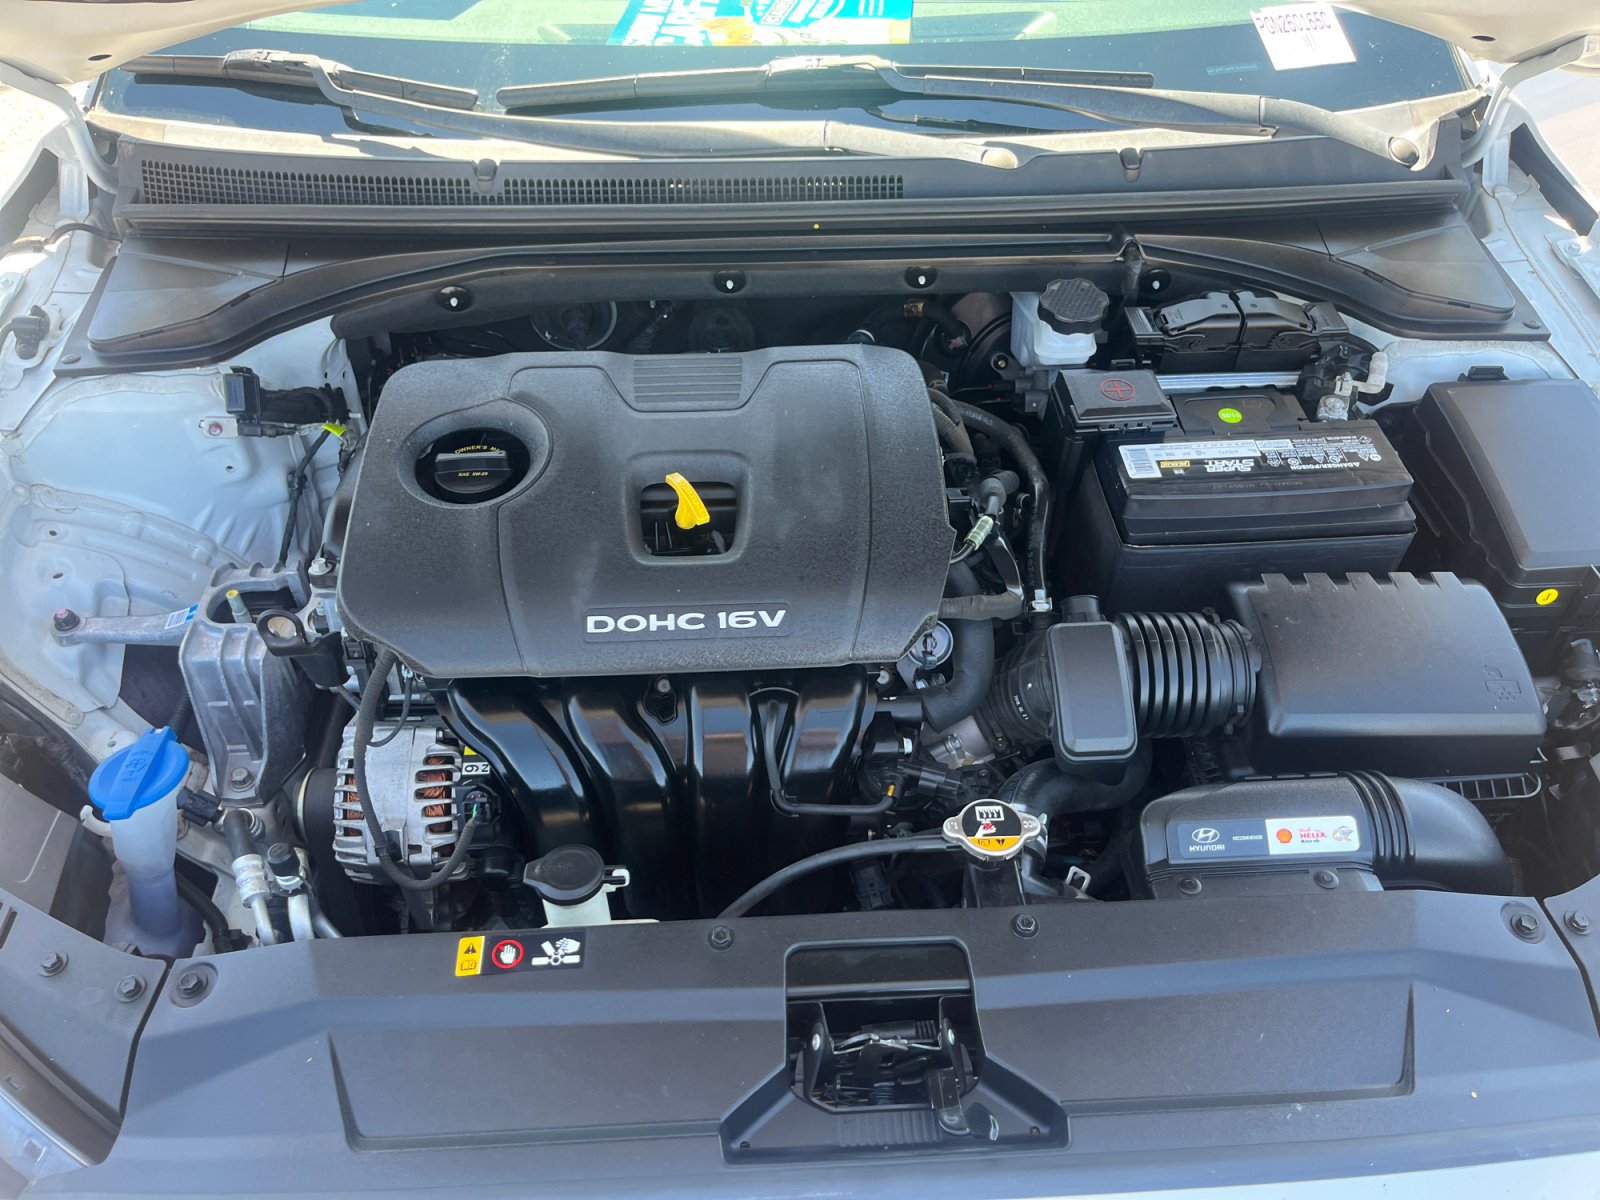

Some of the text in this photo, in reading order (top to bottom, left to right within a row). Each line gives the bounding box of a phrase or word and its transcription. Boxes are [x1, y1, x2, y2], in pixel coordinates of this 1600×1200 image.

[586, 609, 787, 633] DOHC 16V
[1299, 831, 1326, 839] HELIX
[1189, 844, 1225, 852] HYUNDAI
